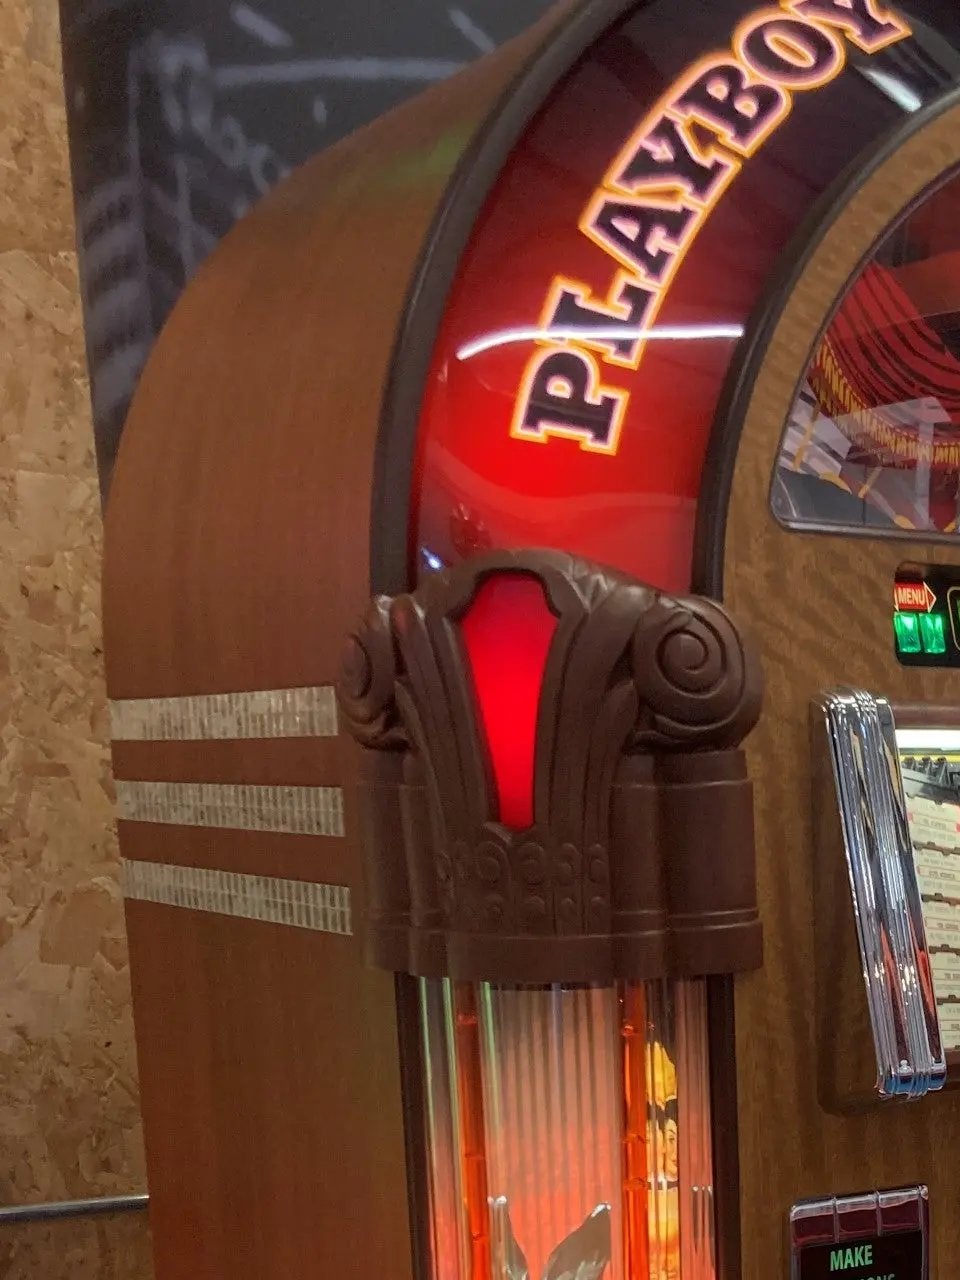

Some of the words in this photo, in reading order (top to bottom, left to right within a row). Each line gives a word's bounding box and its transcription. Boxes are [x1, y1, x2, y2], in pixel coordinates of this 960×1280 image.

[511, 0, 912, 455] PLAYBOY
[897, 588, 926, 605] MENU
[830, 1244, 873, 1272] MAKE
